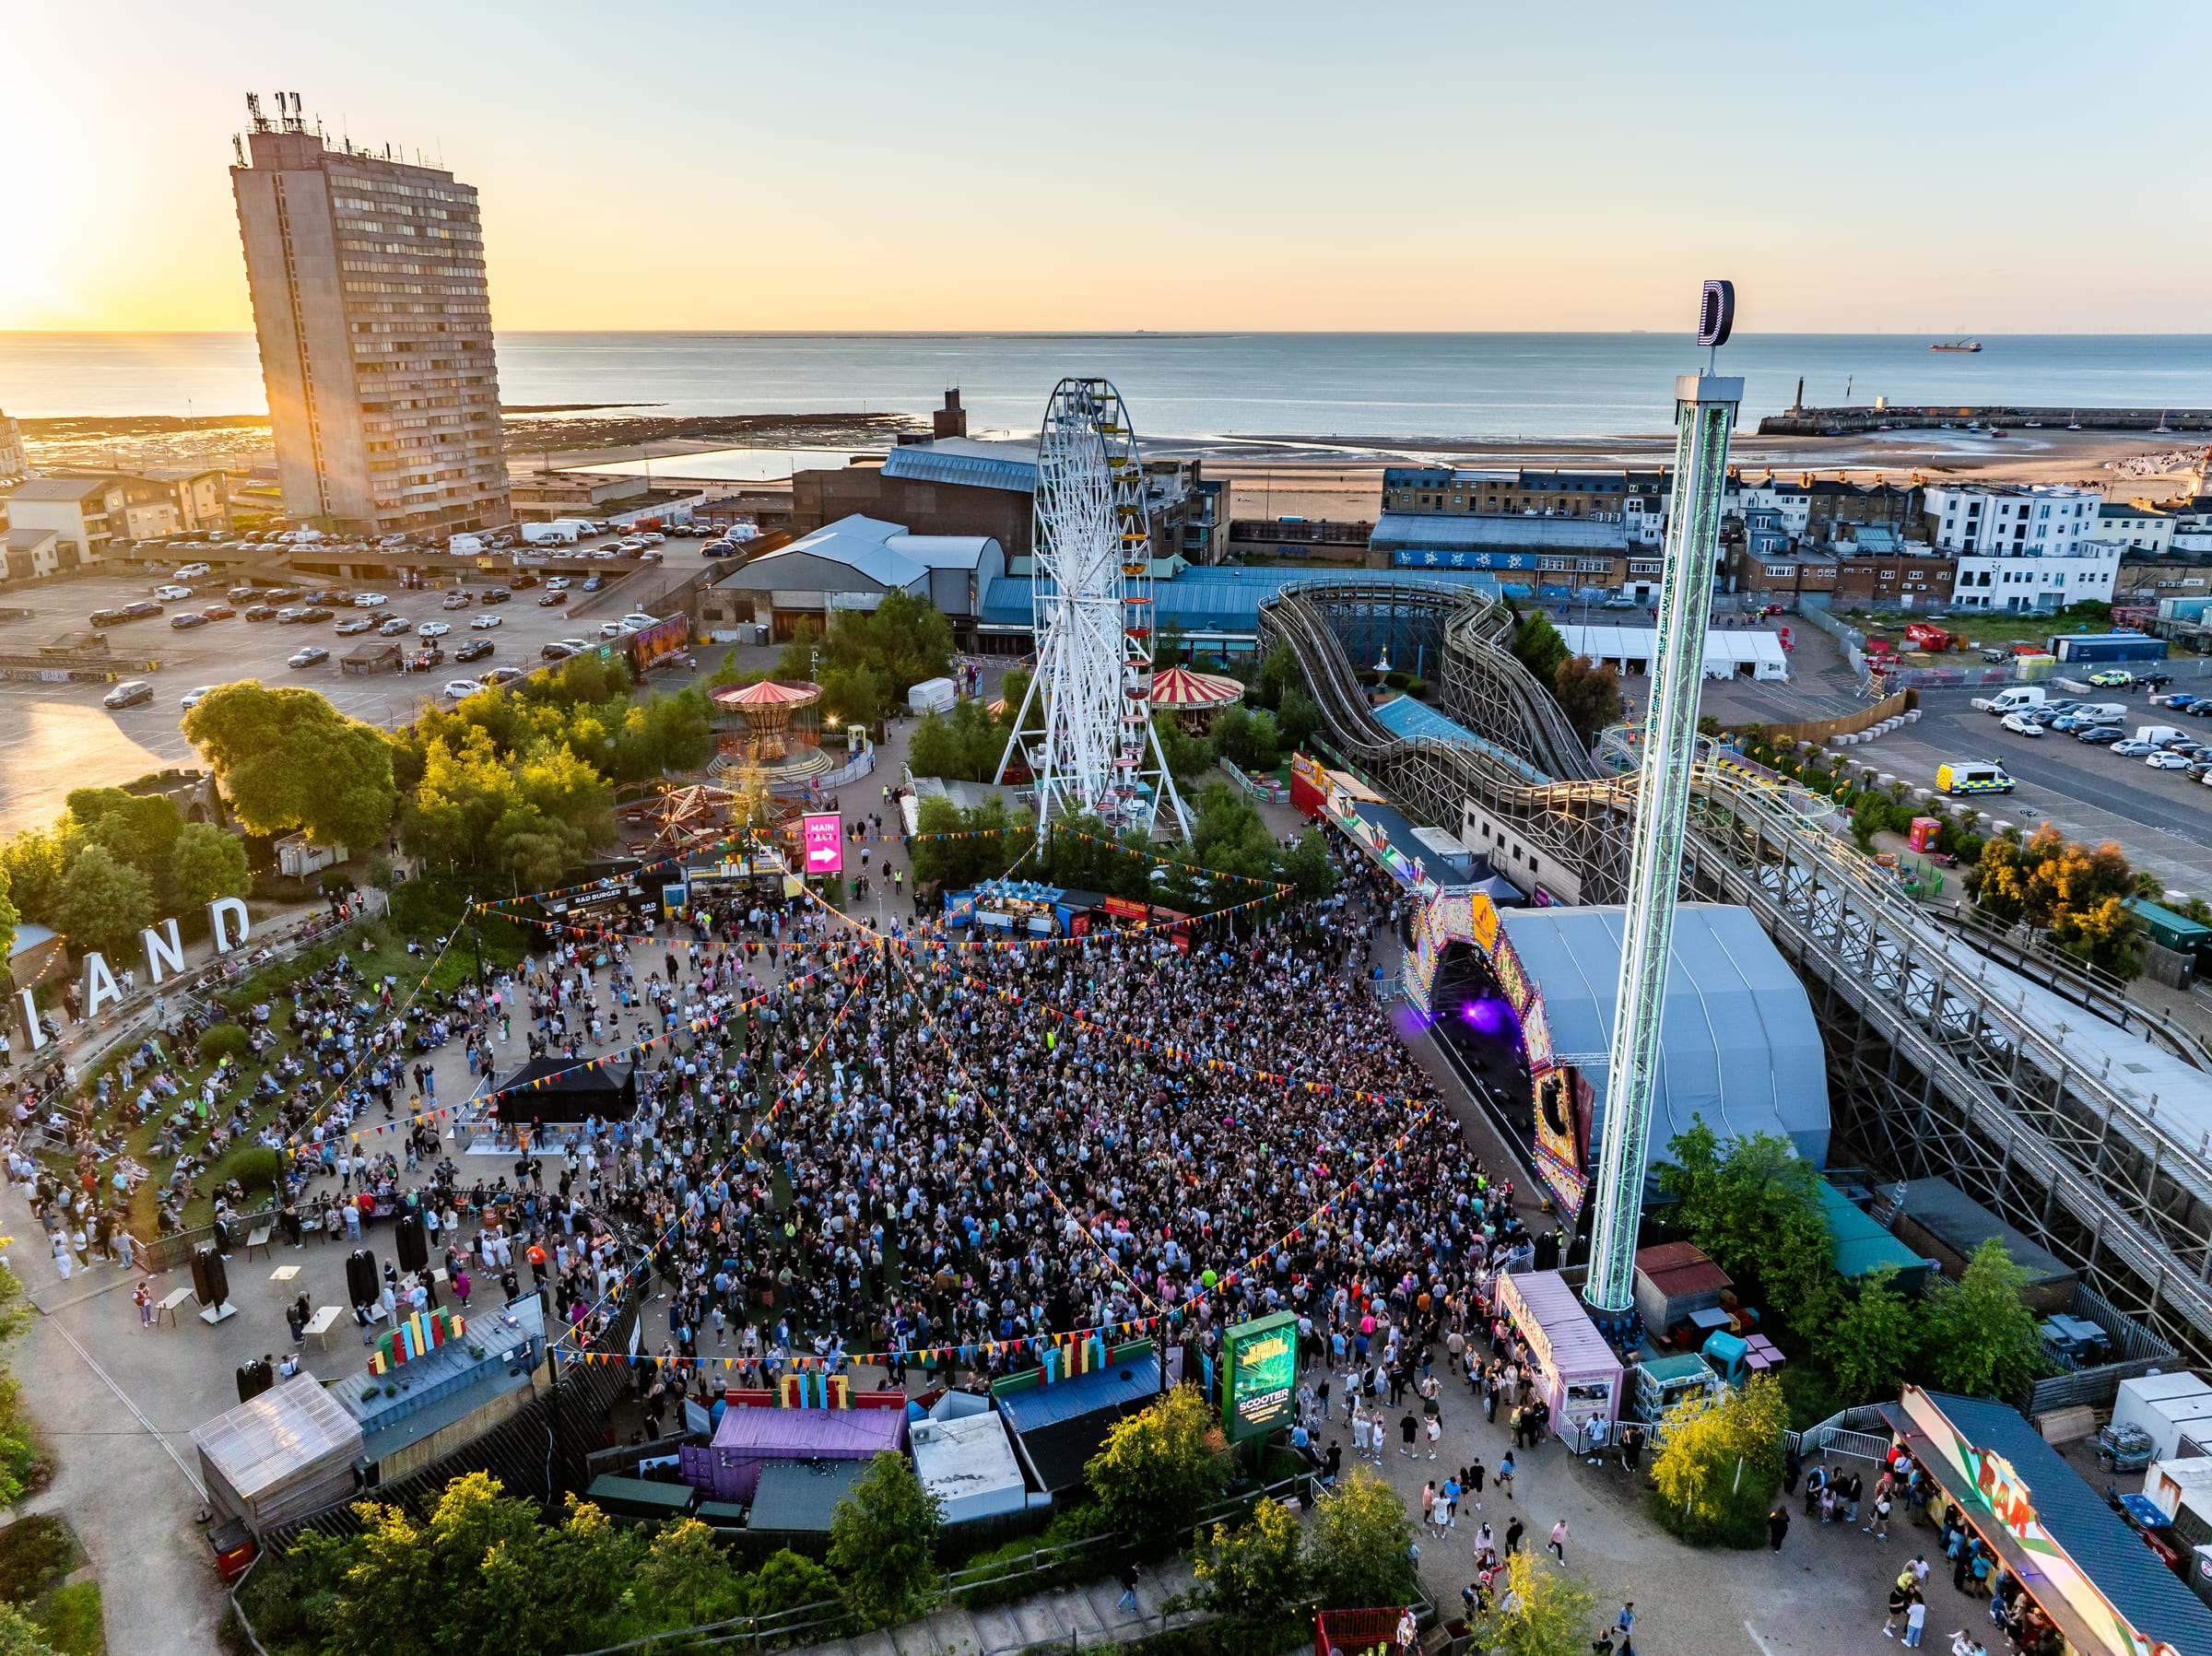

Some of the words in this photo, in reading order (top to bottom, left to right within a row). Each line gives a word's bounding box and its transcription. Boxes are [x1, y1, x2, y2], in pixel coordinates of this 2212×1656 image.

[1698, 280, 1730, 346] D
[811, 824, 834, 832] MAIN
[814, 833, 832, 841] BAR
[721, 863, 749, 877] BAR
[575, 896, 591, 904] RAD
[592, 888, 621, 900] BURGER
[641, 902, 656, 910] RAD
[17, 897, 250, 1051] LAND
[1239, 1388, 1289, 1412] SCOOTER
[1977, 1459, 2030, 1541] BAR
